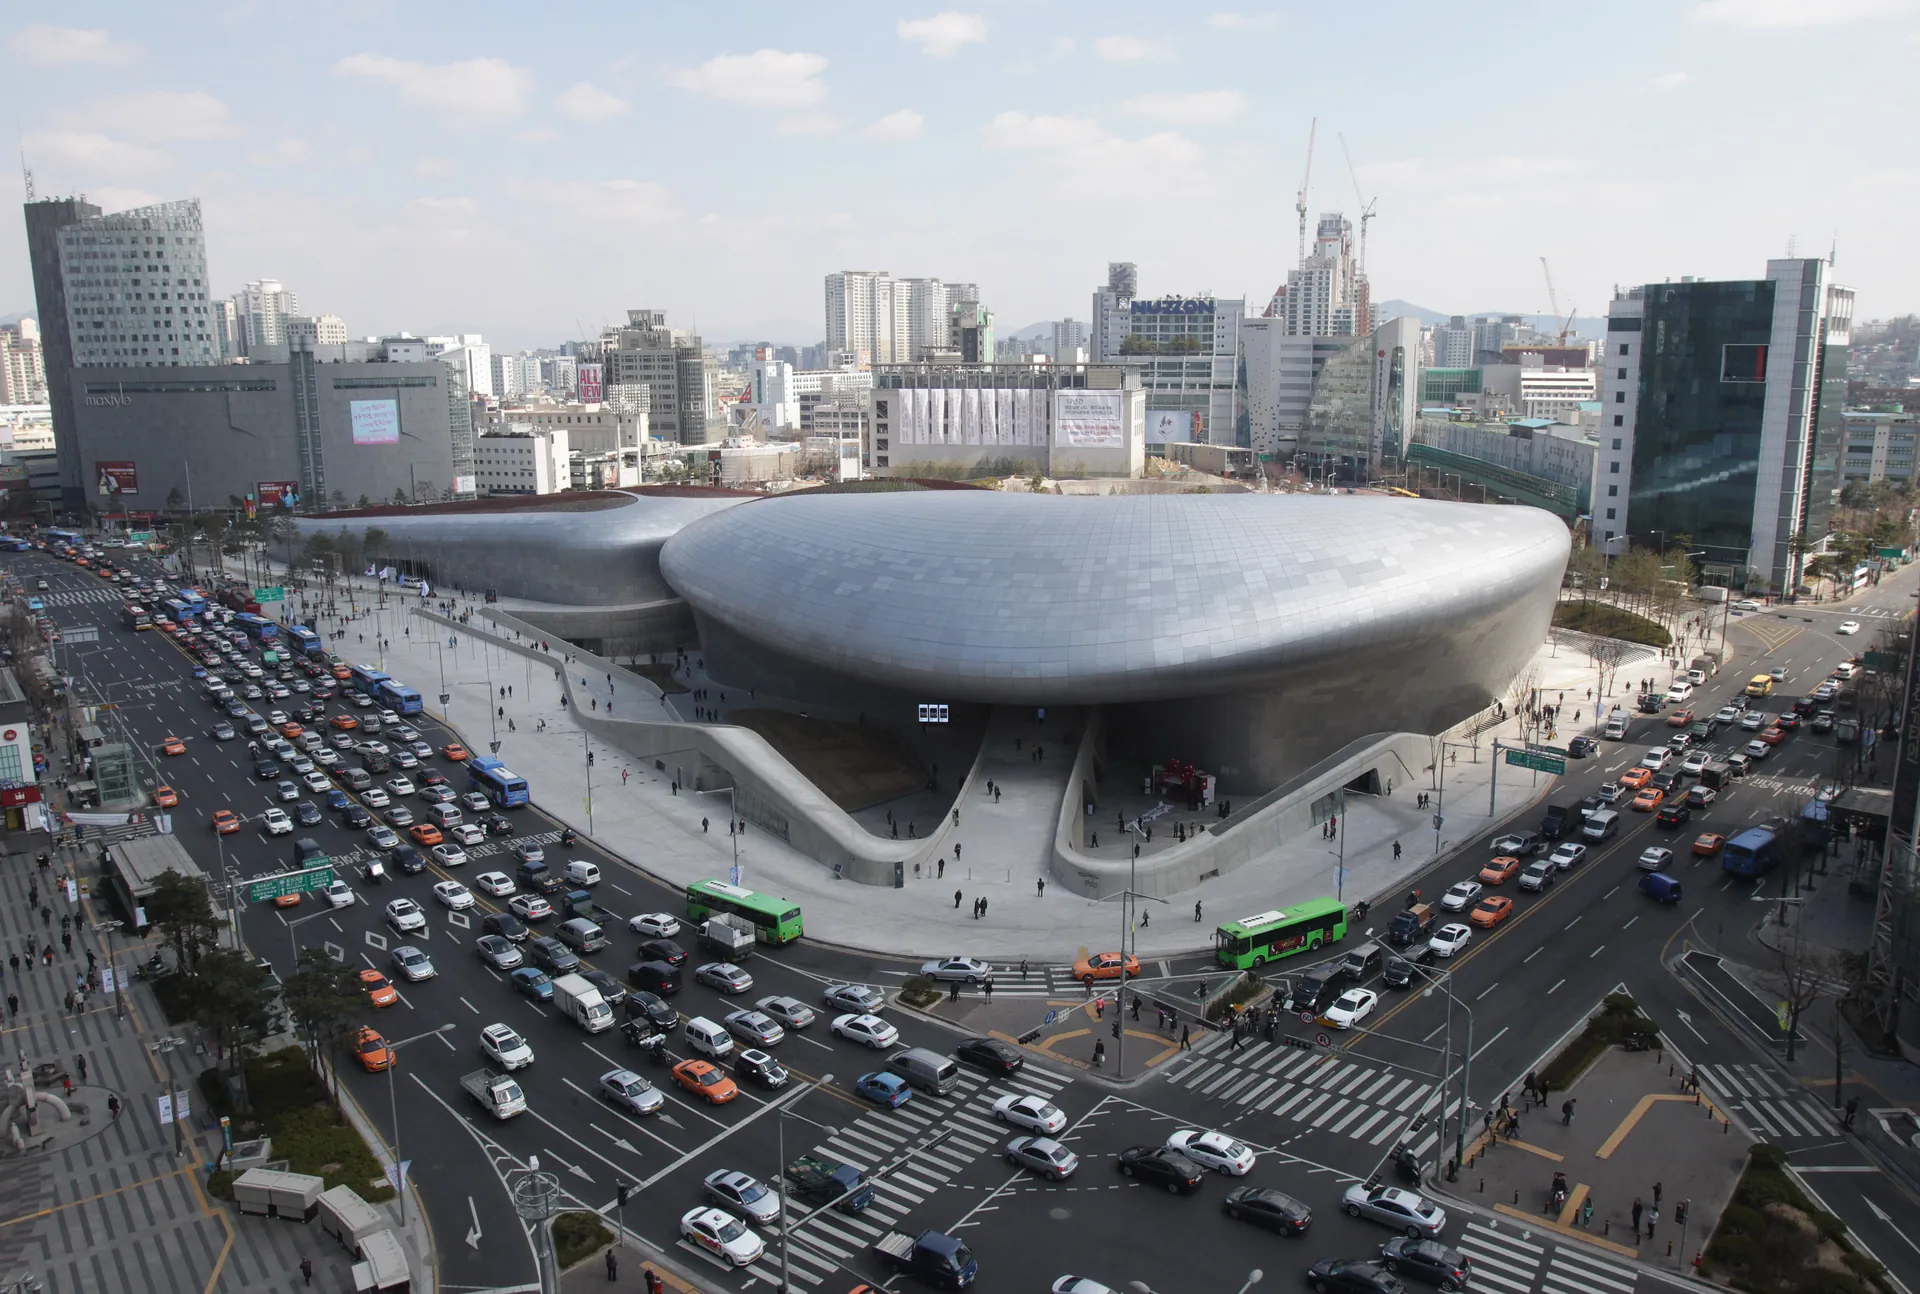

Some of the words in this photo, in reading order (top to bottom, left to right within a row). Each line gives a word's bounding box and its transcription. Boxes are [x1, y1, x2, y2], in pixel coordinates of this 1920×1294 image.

[1131, 300, 1214, 314] NUZZON
[580, 369, 601, 384] ALL
[580, 385, 601, 397] NEW
[466, 843, 503, 858] 동대문
